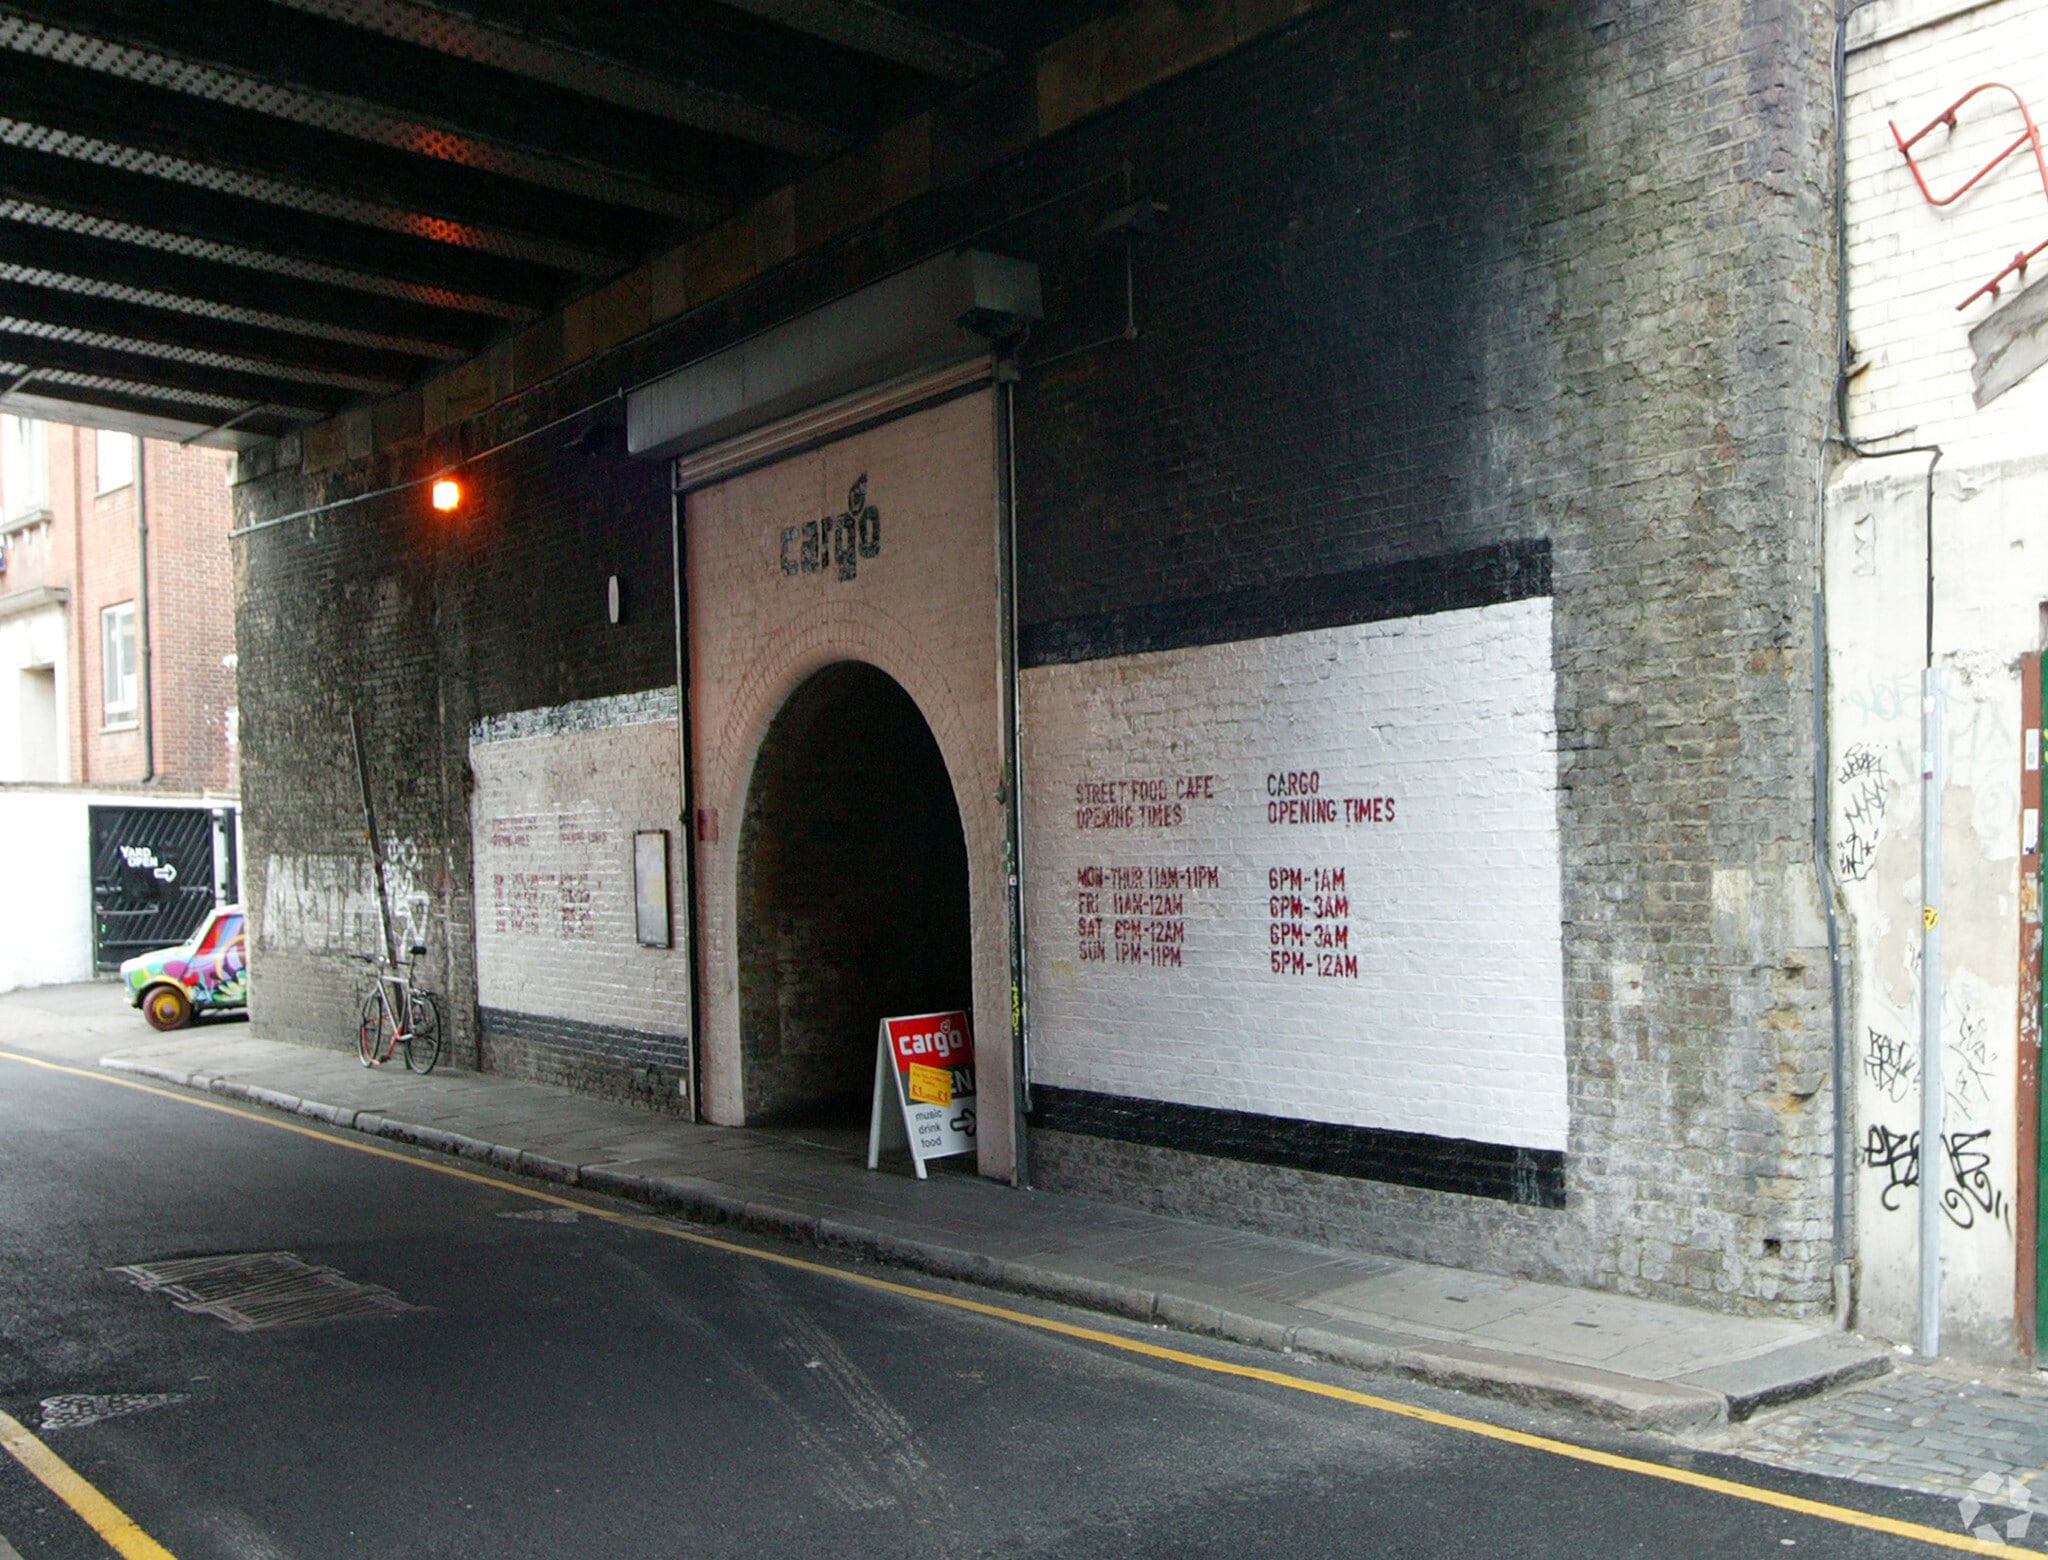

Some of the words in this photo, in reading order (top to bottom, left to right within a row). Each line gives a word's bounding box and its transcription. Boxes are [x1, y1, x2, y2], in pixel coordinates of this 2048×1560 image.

[780, 500, 880, 582] cargo
[1076, 782, 1127, 804] STREET
[1132, 779, 1167, 802] FOOD
[1176, 775, 1214, 799] CAFE
[1267, 770, 1320, 796] CARGO
[1076, 805, 1134, 829] OPENING
[1139, 803, 1183, 828] TIMES
[1268, 798, 1337, 824] OPENING
[1343, 797, 1395, 823] TIMES
[127, 855, 158, 868] OPEN
[1269, 866, 1345, 892] 6PM-1AM
[1079, 892, 1099, 914] FRI
[1114, 892, 1183, 915] 11AM-12AM
[1270, 894, 1348, 919] 6PM-3AM
[1078, 917, 1103, 938] SAT
[1114, 920, 1184, 943] 6PM-12AM
[1270, 922, 1348, 950] 6PM-3AM
[1079, 941, 1105, 963] SUN
[1115, 942, 1182, 967] 1PM-11PM
[1271, 950, 1358, 979] 5PM-12AM
[898, 1026, 963, 1058] cargo
[915, 1108, 943, 1121] music
[918, 1123, 942, 1135] drink
[920, 1135, 943, 1148] food
